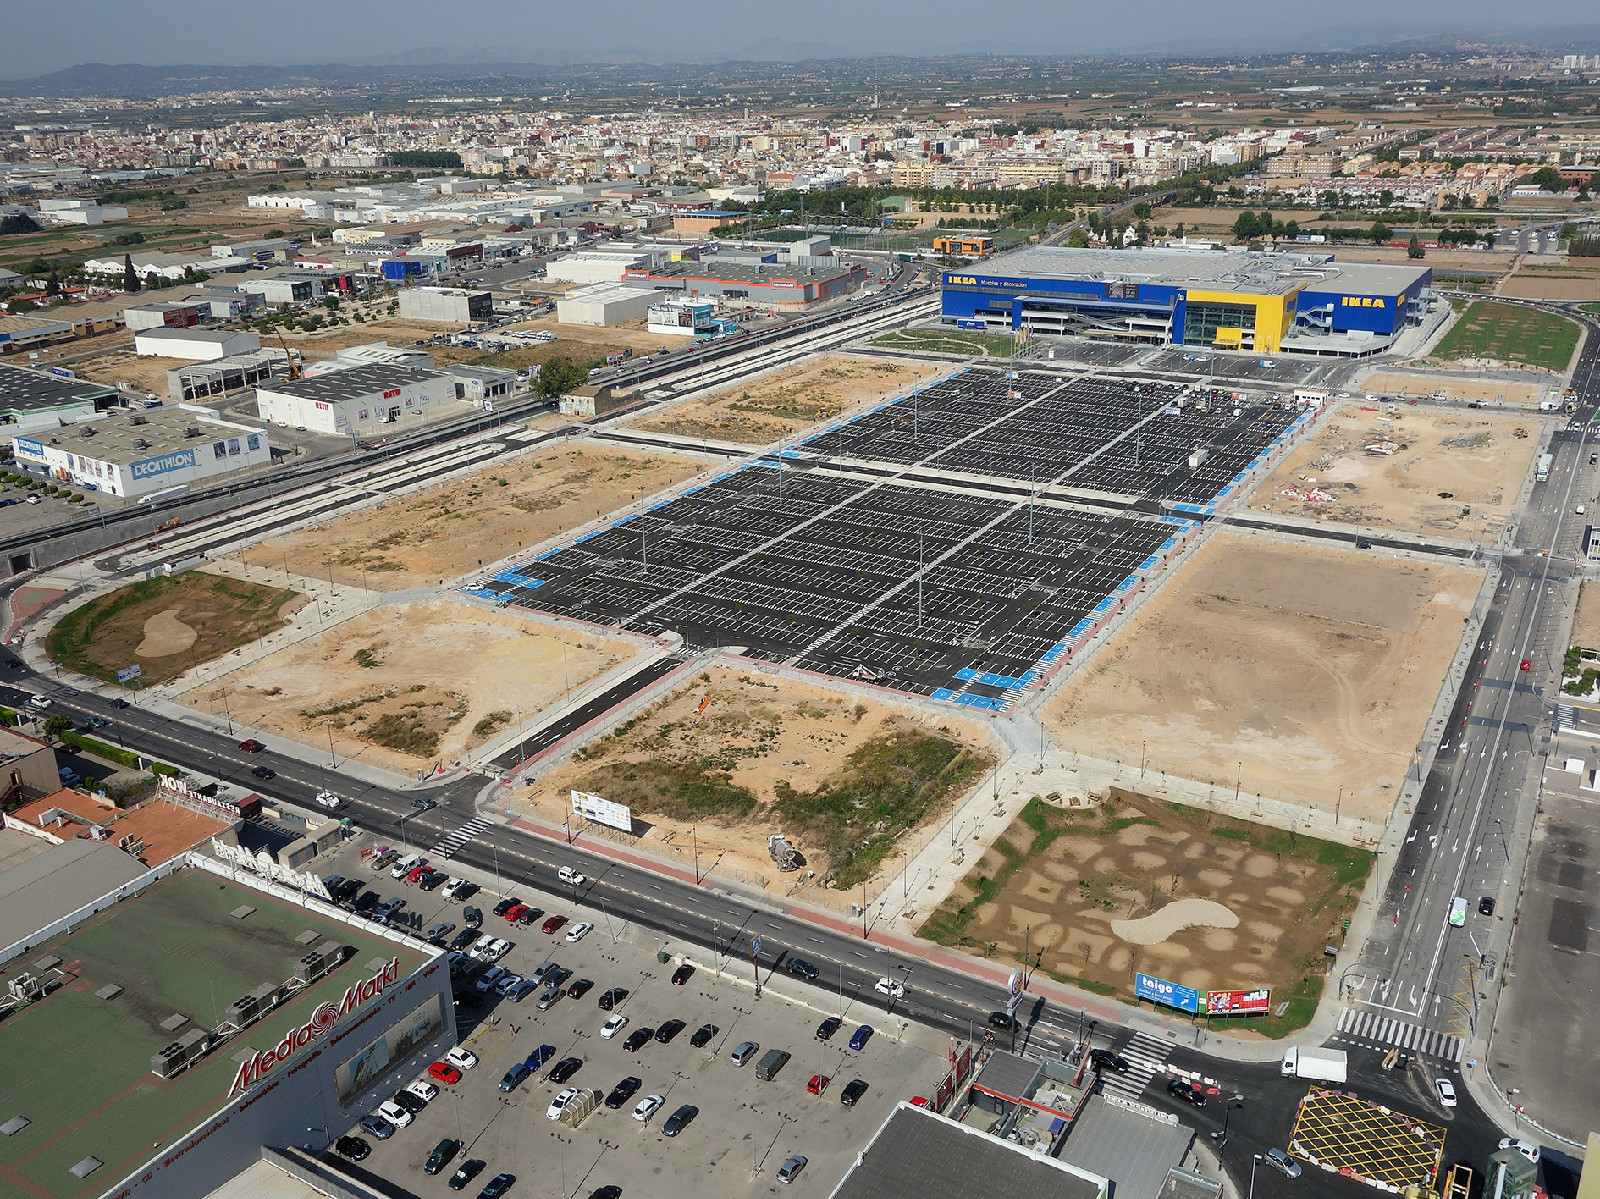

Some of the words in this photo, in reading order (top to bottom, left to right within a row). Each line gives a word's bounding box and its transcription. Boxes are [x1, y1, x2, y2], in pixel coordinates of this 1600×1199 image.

[948, 275, 977, 284] IKEA
[1342, 296, 1385, 308] IKEA
[19, 438, 42, 452] DECATHLON
[134, 453, 193, 476] DECATHLON
[227, 1022, 313, 1099] Media
[336, 956, 400, 1021] Markt
